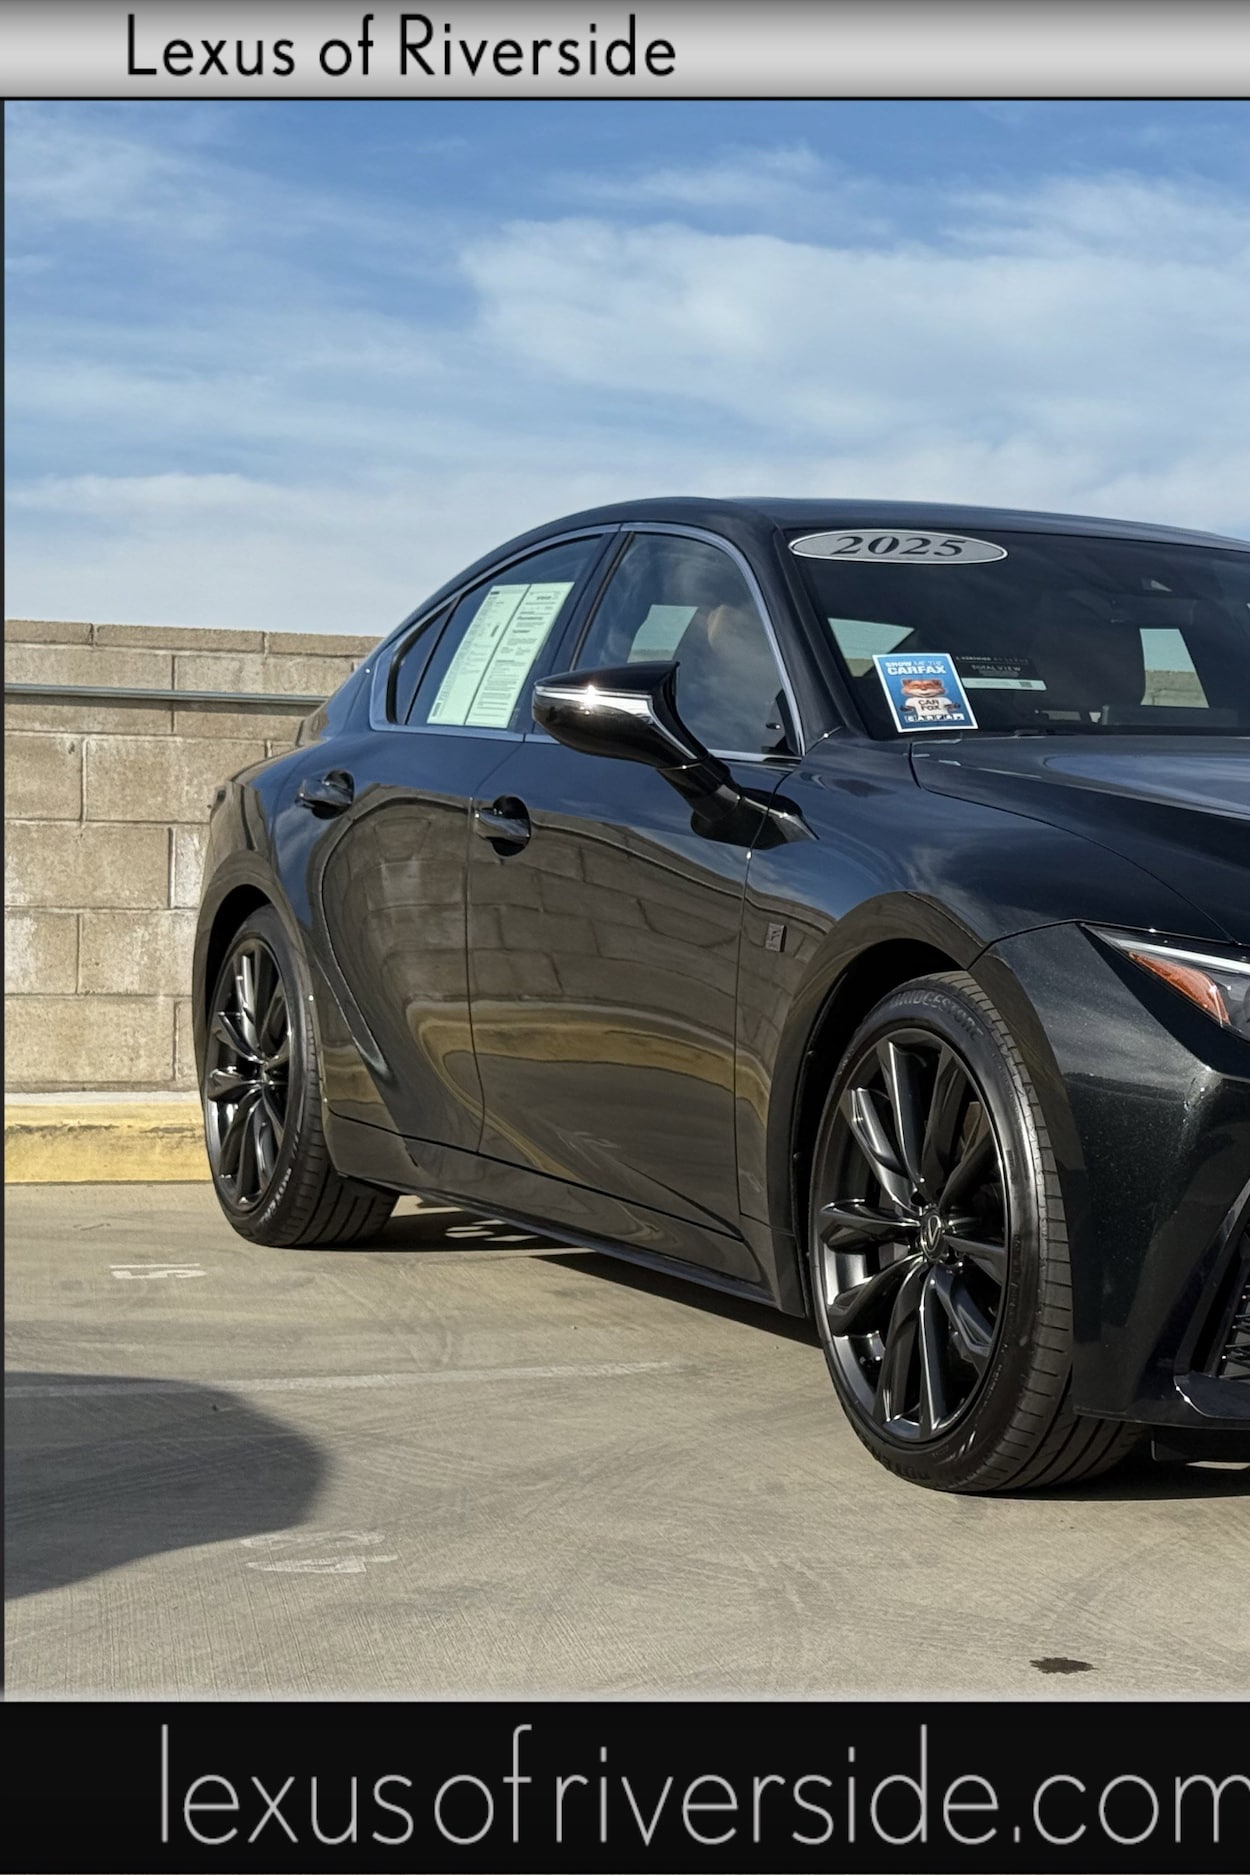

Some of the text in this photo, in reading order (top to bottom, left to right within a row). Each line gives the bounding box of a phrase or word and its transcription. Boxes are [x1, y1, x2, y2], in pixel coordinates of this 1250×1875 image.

[831, 535, 967, 557] 2025
[887, 665, 947, 676] CARFAX
[917, 698, 940, 706] CAR
[920, 704, 942, 712] FOX
